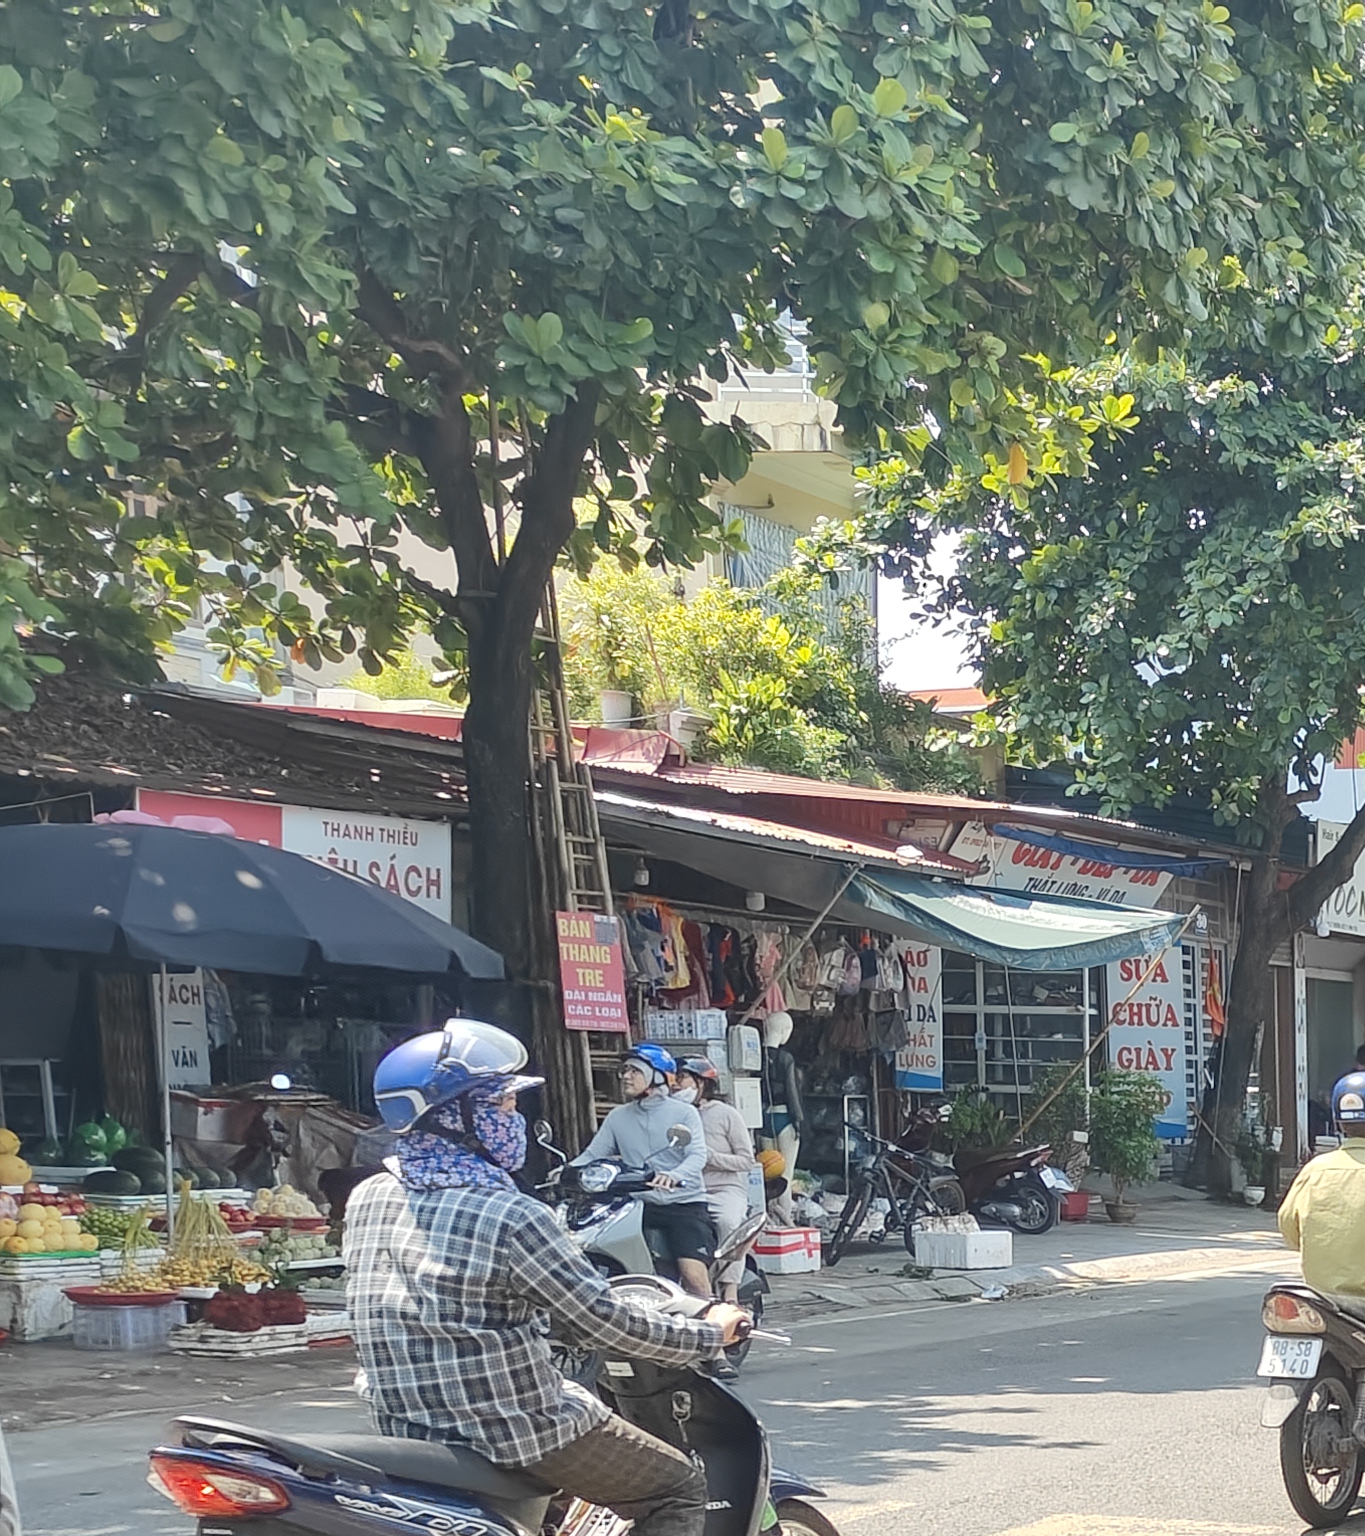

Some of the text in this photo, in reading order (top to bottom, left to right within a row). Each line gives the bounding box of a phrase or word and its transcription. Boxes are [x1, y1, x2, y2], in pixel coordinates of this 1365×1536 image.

[322, 821, 374, 842] THANH
[559, 915, 591, 938] BÁN
[560, 943, 611, 964] THANG
[576, 968, 605, 988] TRE
[159, 978, 201, 1005] ÁCH
[1112, 996, 1180, 1027] CHỮA
[171, 1045, 198, 1068] VĂN
[1117, 1040, 1177, 1071] GIÀY
[1266, 1359, 1310, 1375] 5140
